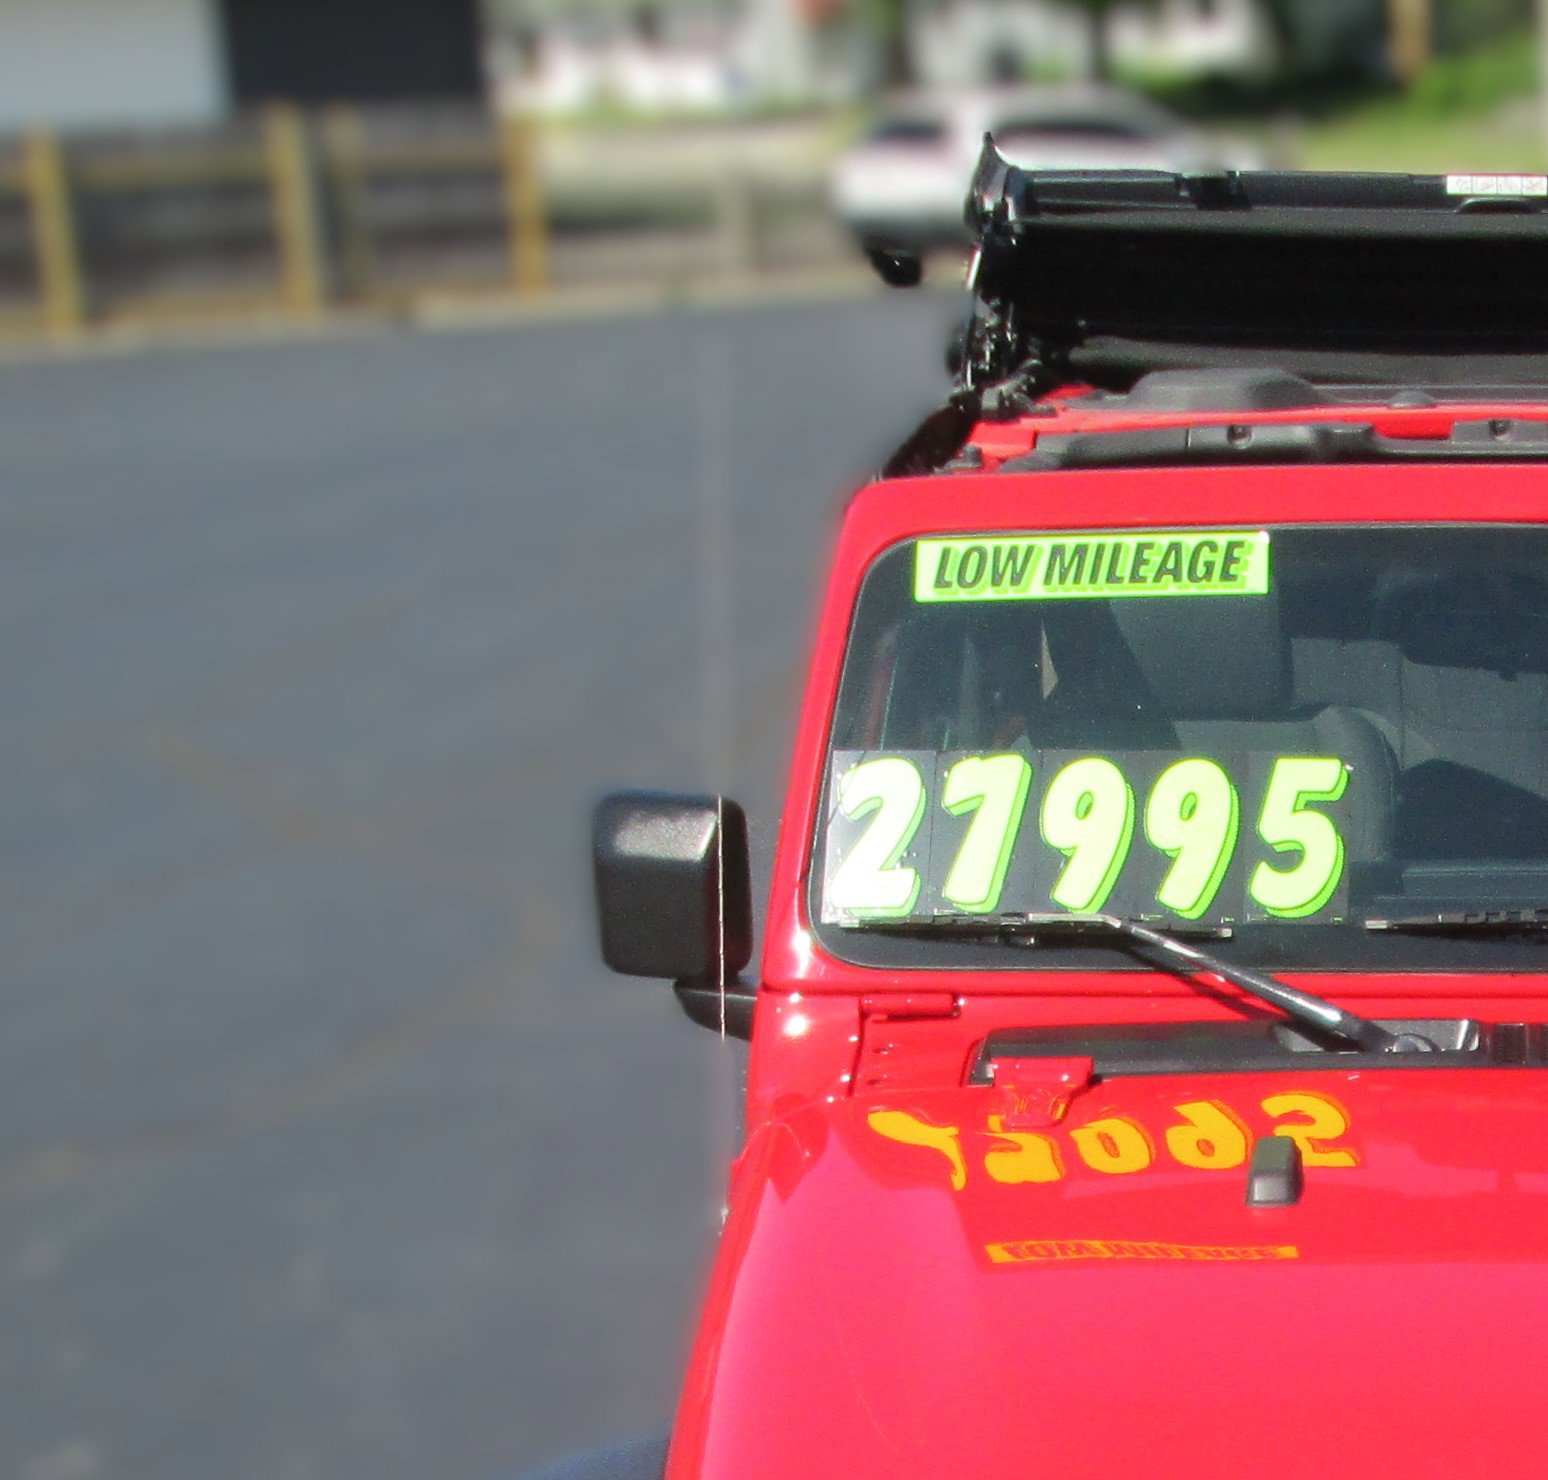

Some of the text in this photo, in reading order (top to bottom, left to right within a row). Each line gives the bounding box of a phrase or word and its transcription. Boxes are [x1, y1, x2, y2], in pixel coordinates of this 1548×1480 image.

[933, 540, 1247, 590] LOW MILEAGE
[829, 754, 1347, 918] 27995
